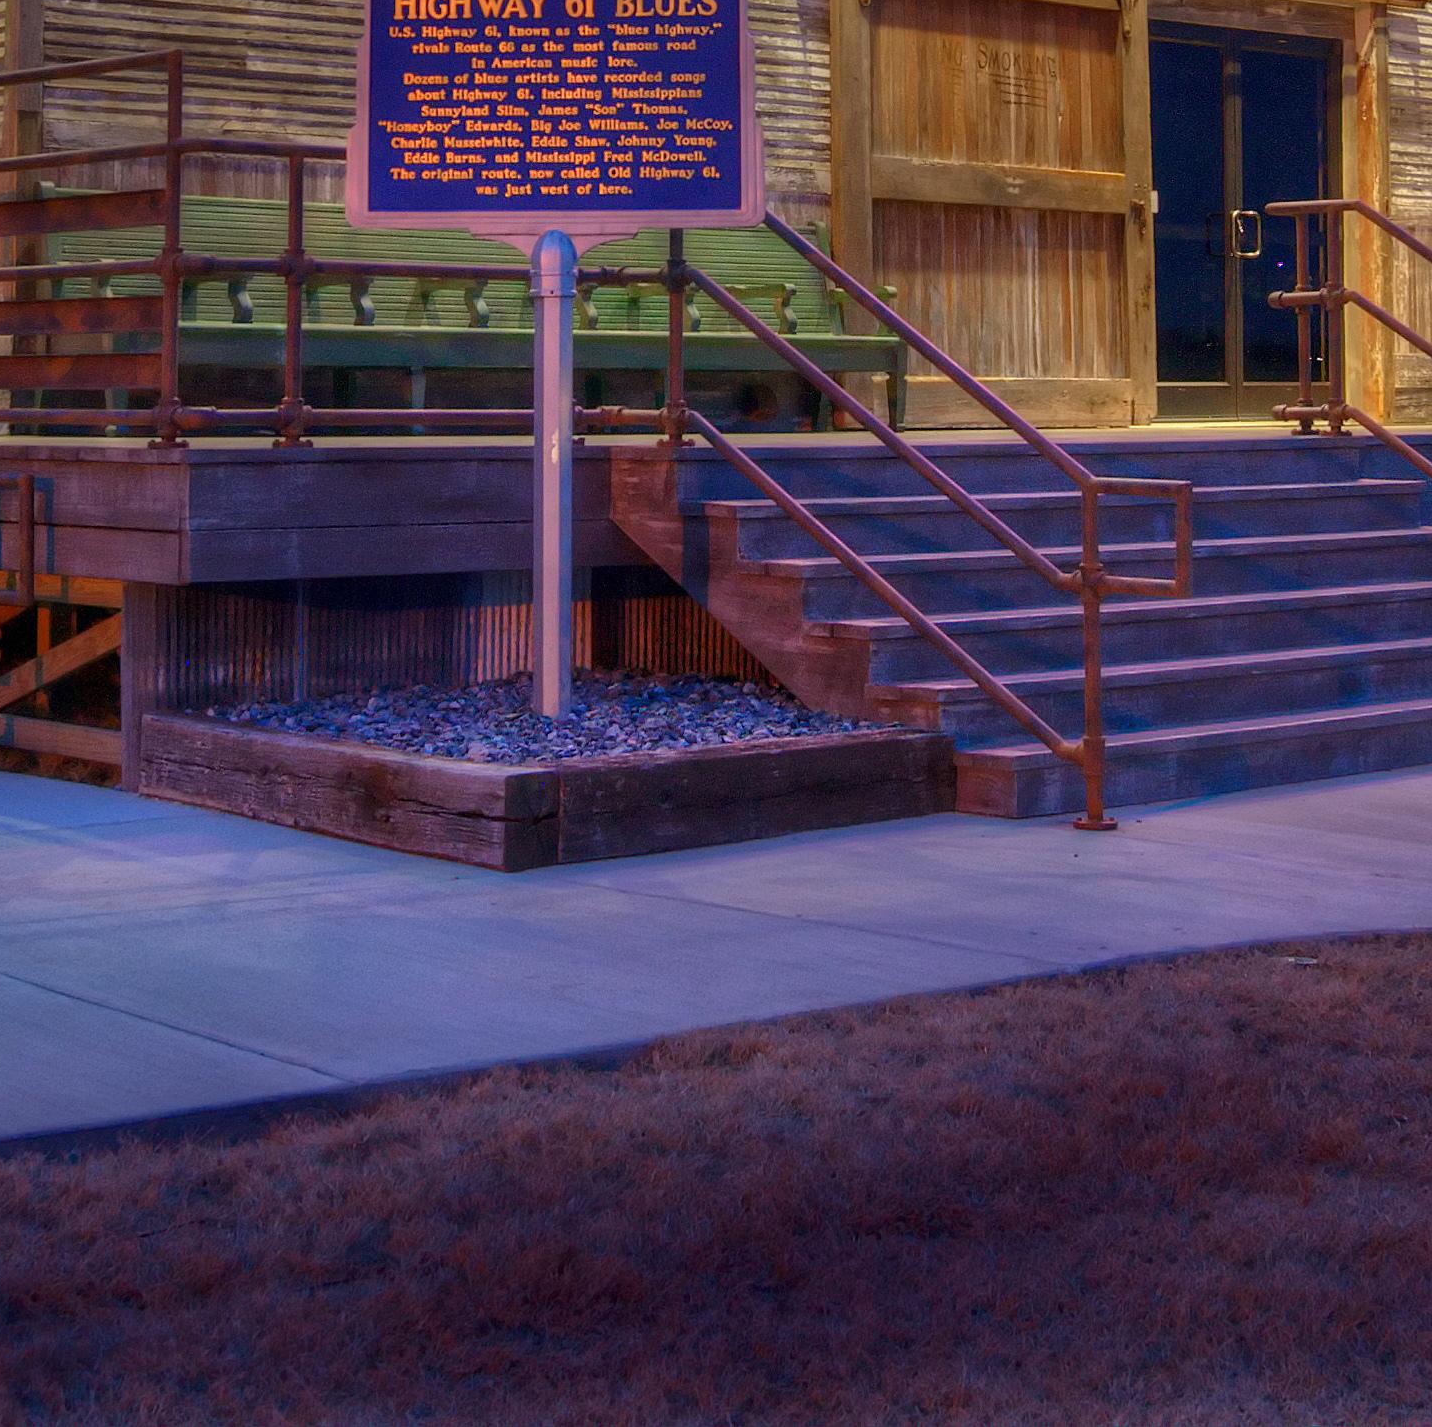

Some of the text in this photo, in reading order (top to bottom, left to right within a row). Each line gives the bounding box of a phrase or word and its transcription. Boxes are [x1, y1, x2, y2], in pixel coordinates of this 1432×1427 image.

[389, 26, 416, 38] U.S.
[421, 25, 477, 40] Highway
[508, 25, 550, 37] known
[555, 27, 570, 36] as
[577, 24, 600, 36] the
[412, 40, 696, 54] rivals Route 66 as the most famous road
[471, 55, 637, 69] in American music lore.
[403, 71, 705, 85] Dozens of blues artists have recorded songs
[407, 89, 446, 101] about
[452, 88, 508, 103] Highway
[541, 87, 602, 101] including
[611, 87, 702, 101] Mississippians
[420, 104, 490, 119] Sunnyland
[537, 104, 578, 116] James
[530, 119, 552, 134] Big
[558, 119, 582, 131] Joe
[656, 118, 678, 130] Joe
[390, 136, 438, 149] Charlie
[531, 135, 569, 148] Eddie
[616, 134, 666, 148] Johnny
[403, 151, 441, 164] Eddie
[494, 151, 519, 164] and
[525, 151, 596, 166] Mississippi
[603, 150, 633, 163] Fred
[641, 150, 706, 163] McDowell.
[390, 167, 416, 180] The
[421, 167, 474, 182] original
[528, 169, 554, 179] now
[560, 167, 600, 179] called
[608, 166, 632, 179] Old
[639, 166, 693, 180] Highway
[475, 183, 633, 198] was just west of here.
